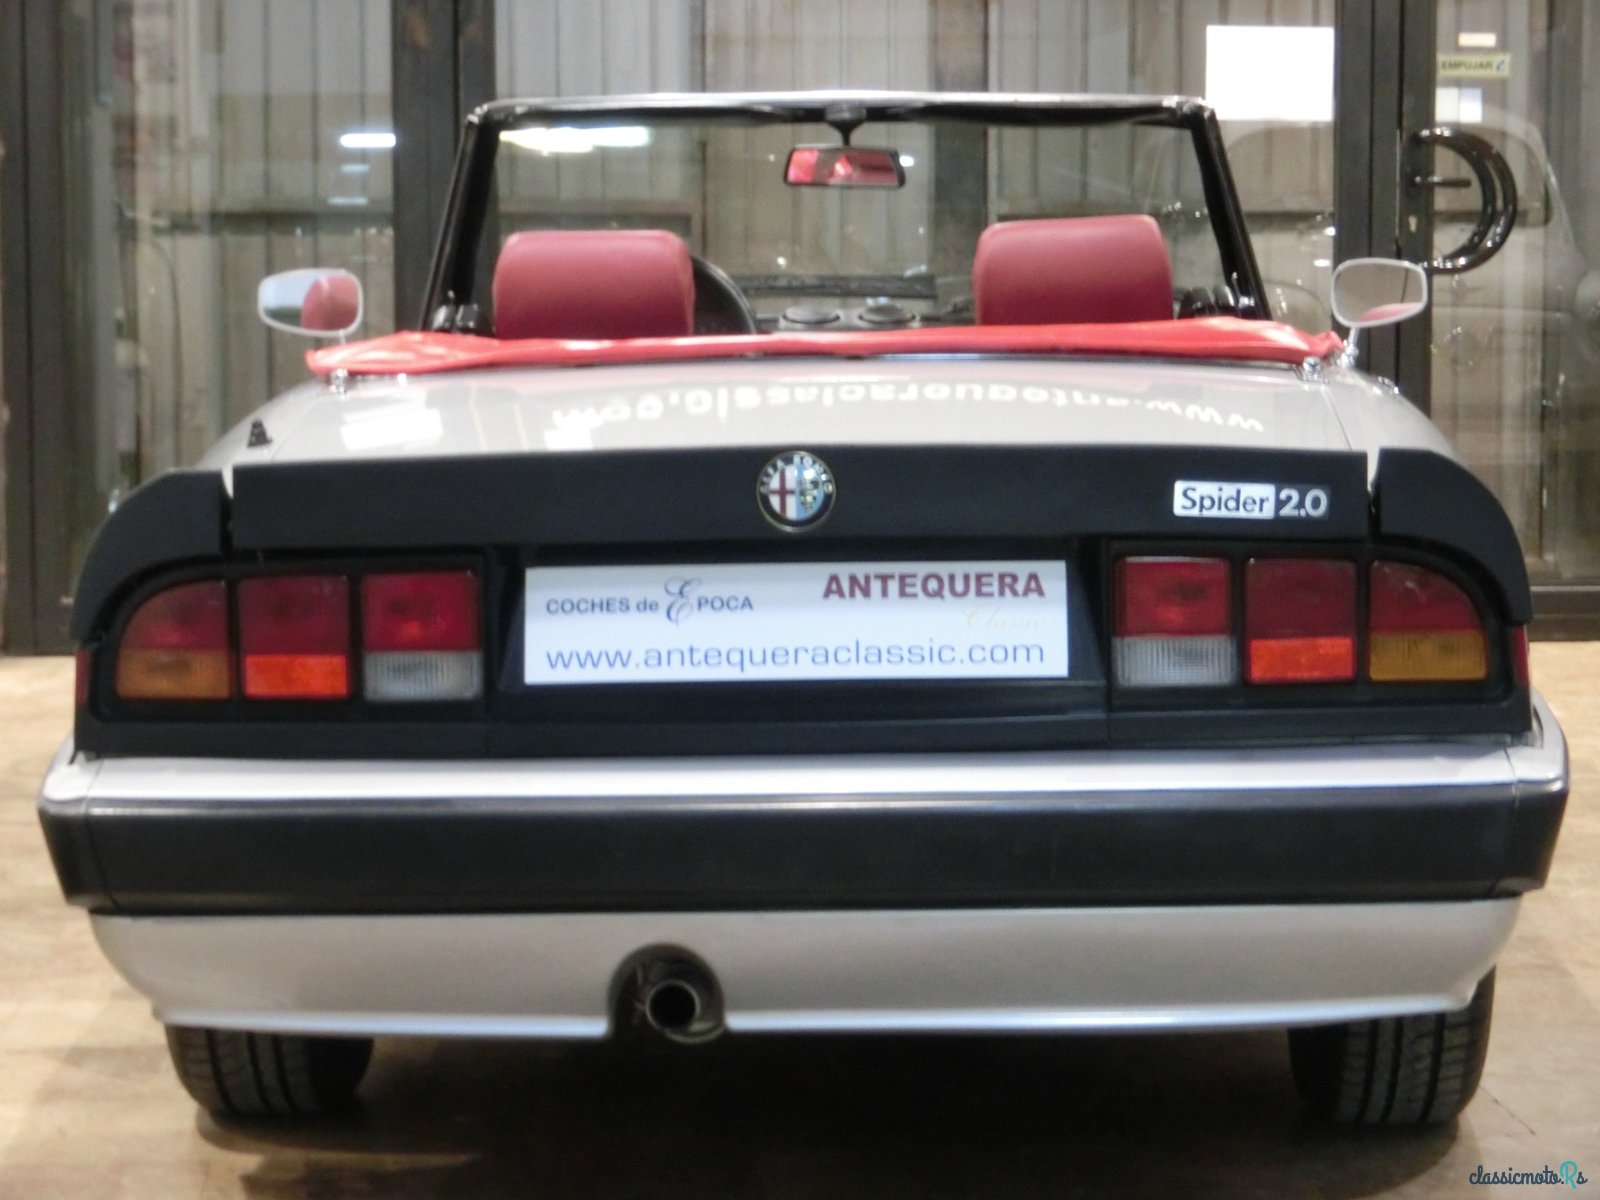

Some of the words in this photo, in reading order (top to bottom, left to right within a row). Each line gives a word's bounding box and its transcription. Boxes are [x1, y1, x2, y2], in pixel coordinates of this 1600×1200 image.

[1441, 60, 1494, 71] EMPUJAR
[1181, 486, 1269, 515] Spider
[1278, 488, 1328, 517] 2.0
[823, 571, 1046, 600] ANTEQUERA
[546, 596, 630, 615] COCHES
[636, 597, 660, 613] de
[545, 638, 1045, 673] www.antequeraclassic.com
